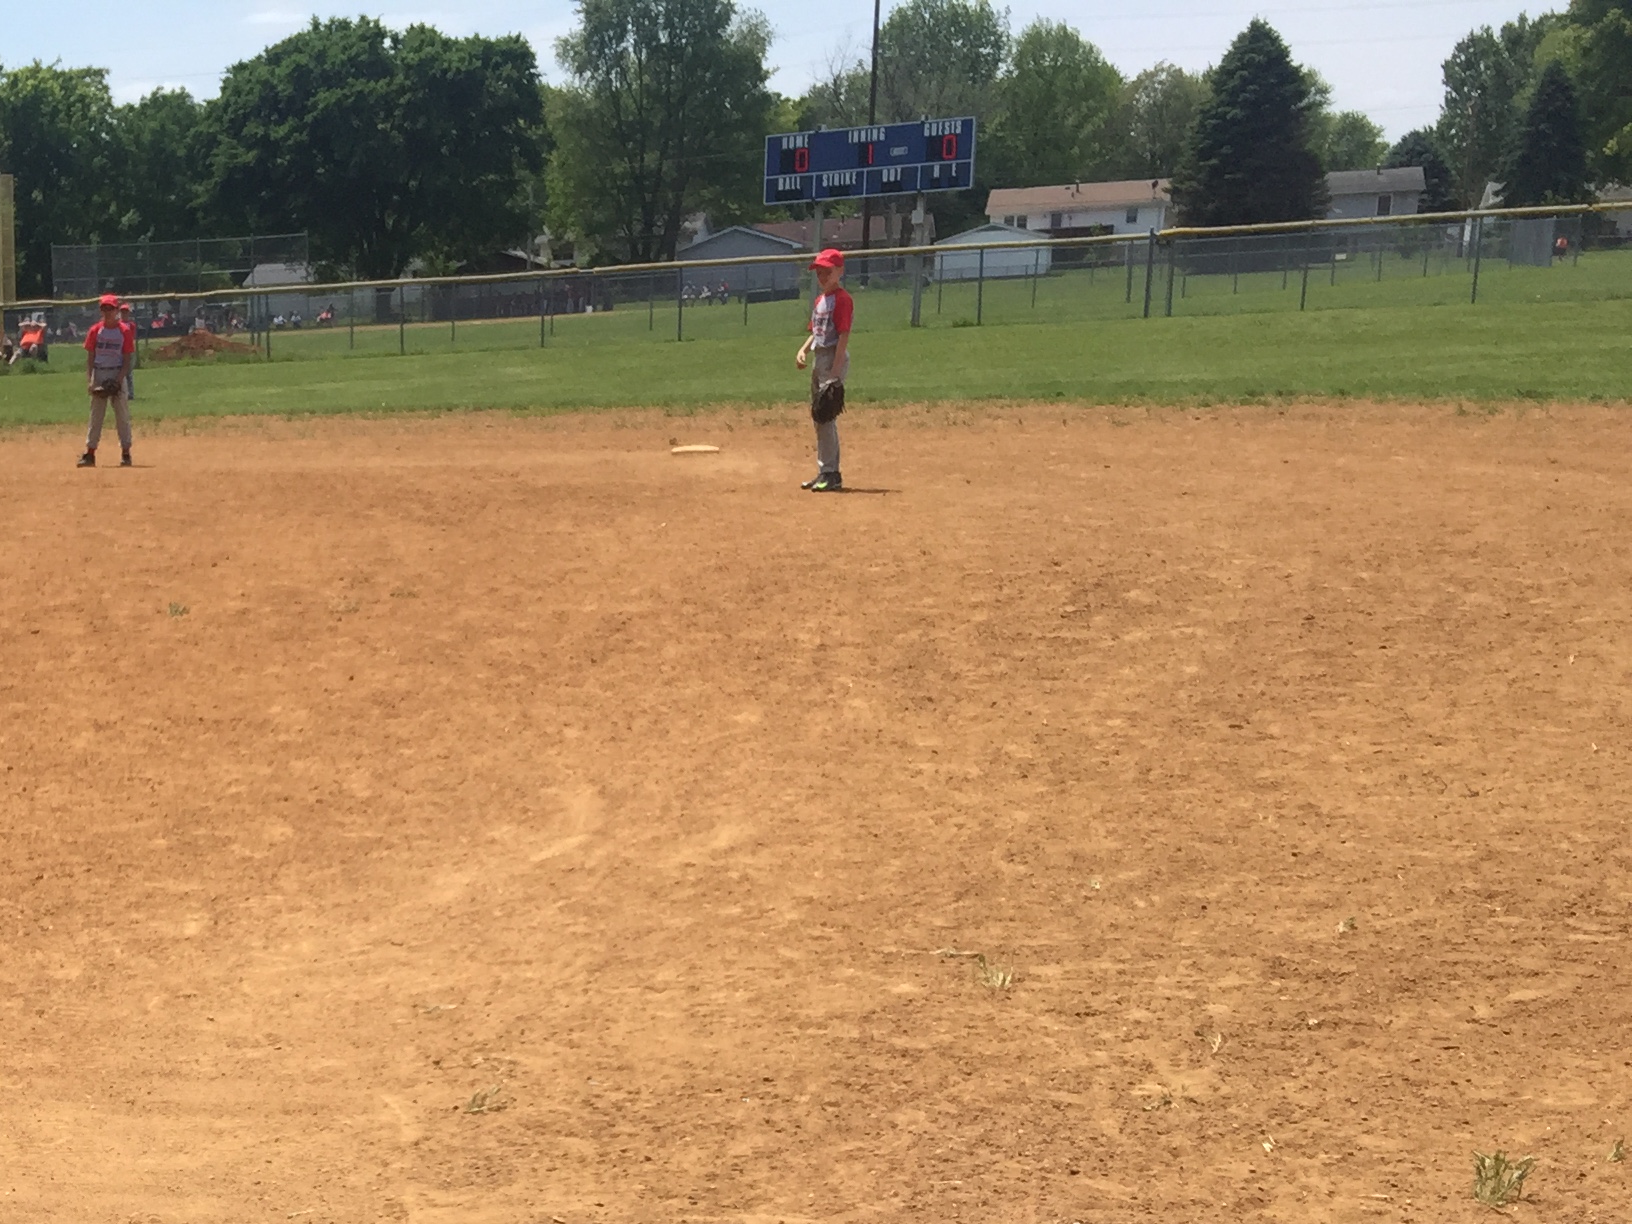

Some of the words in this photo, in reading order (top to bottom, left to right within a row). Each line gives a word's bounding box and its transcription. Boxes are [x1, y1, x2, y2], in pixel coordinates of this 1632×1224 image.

[848, 127, 886, 143] INNING
[924, 120, 962, 137] GUESTS
[782, 134, 809, 150] HOME
[942, 134, 957, 160] 0
[794, 147, 809, 173] 0
[867, 143, 874, 165] 1
[822, 171, 857, 187] STRIKE
[882, 167, 902, 182] OUT
[778, 176, 801, 191] BALL
